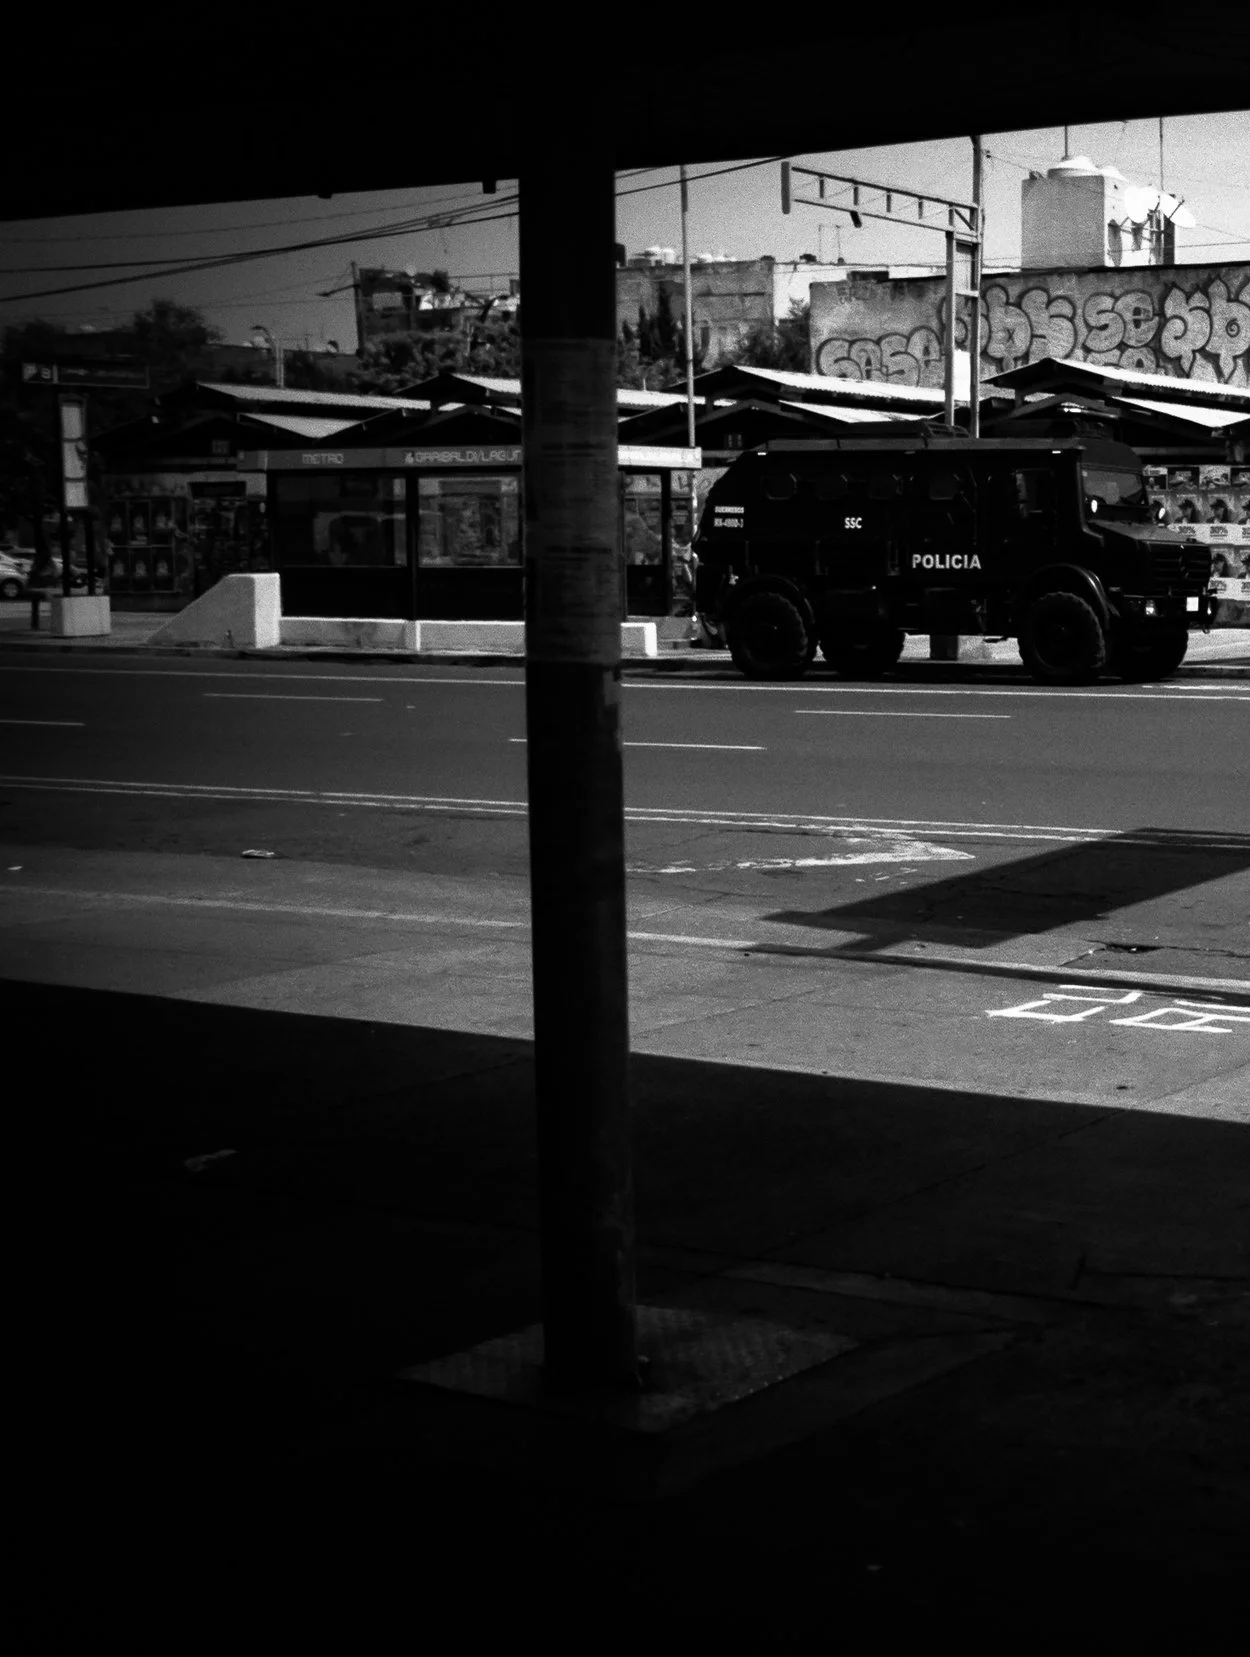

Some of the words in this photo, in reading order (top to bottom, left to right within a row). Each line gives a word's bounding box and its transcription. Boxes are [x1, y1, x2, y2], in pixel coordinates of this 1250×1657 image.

[302, 452, 344, 465] METRO
[844, 517, 863, 530] SSC
[911, 554, 982, 569] POLICIA
